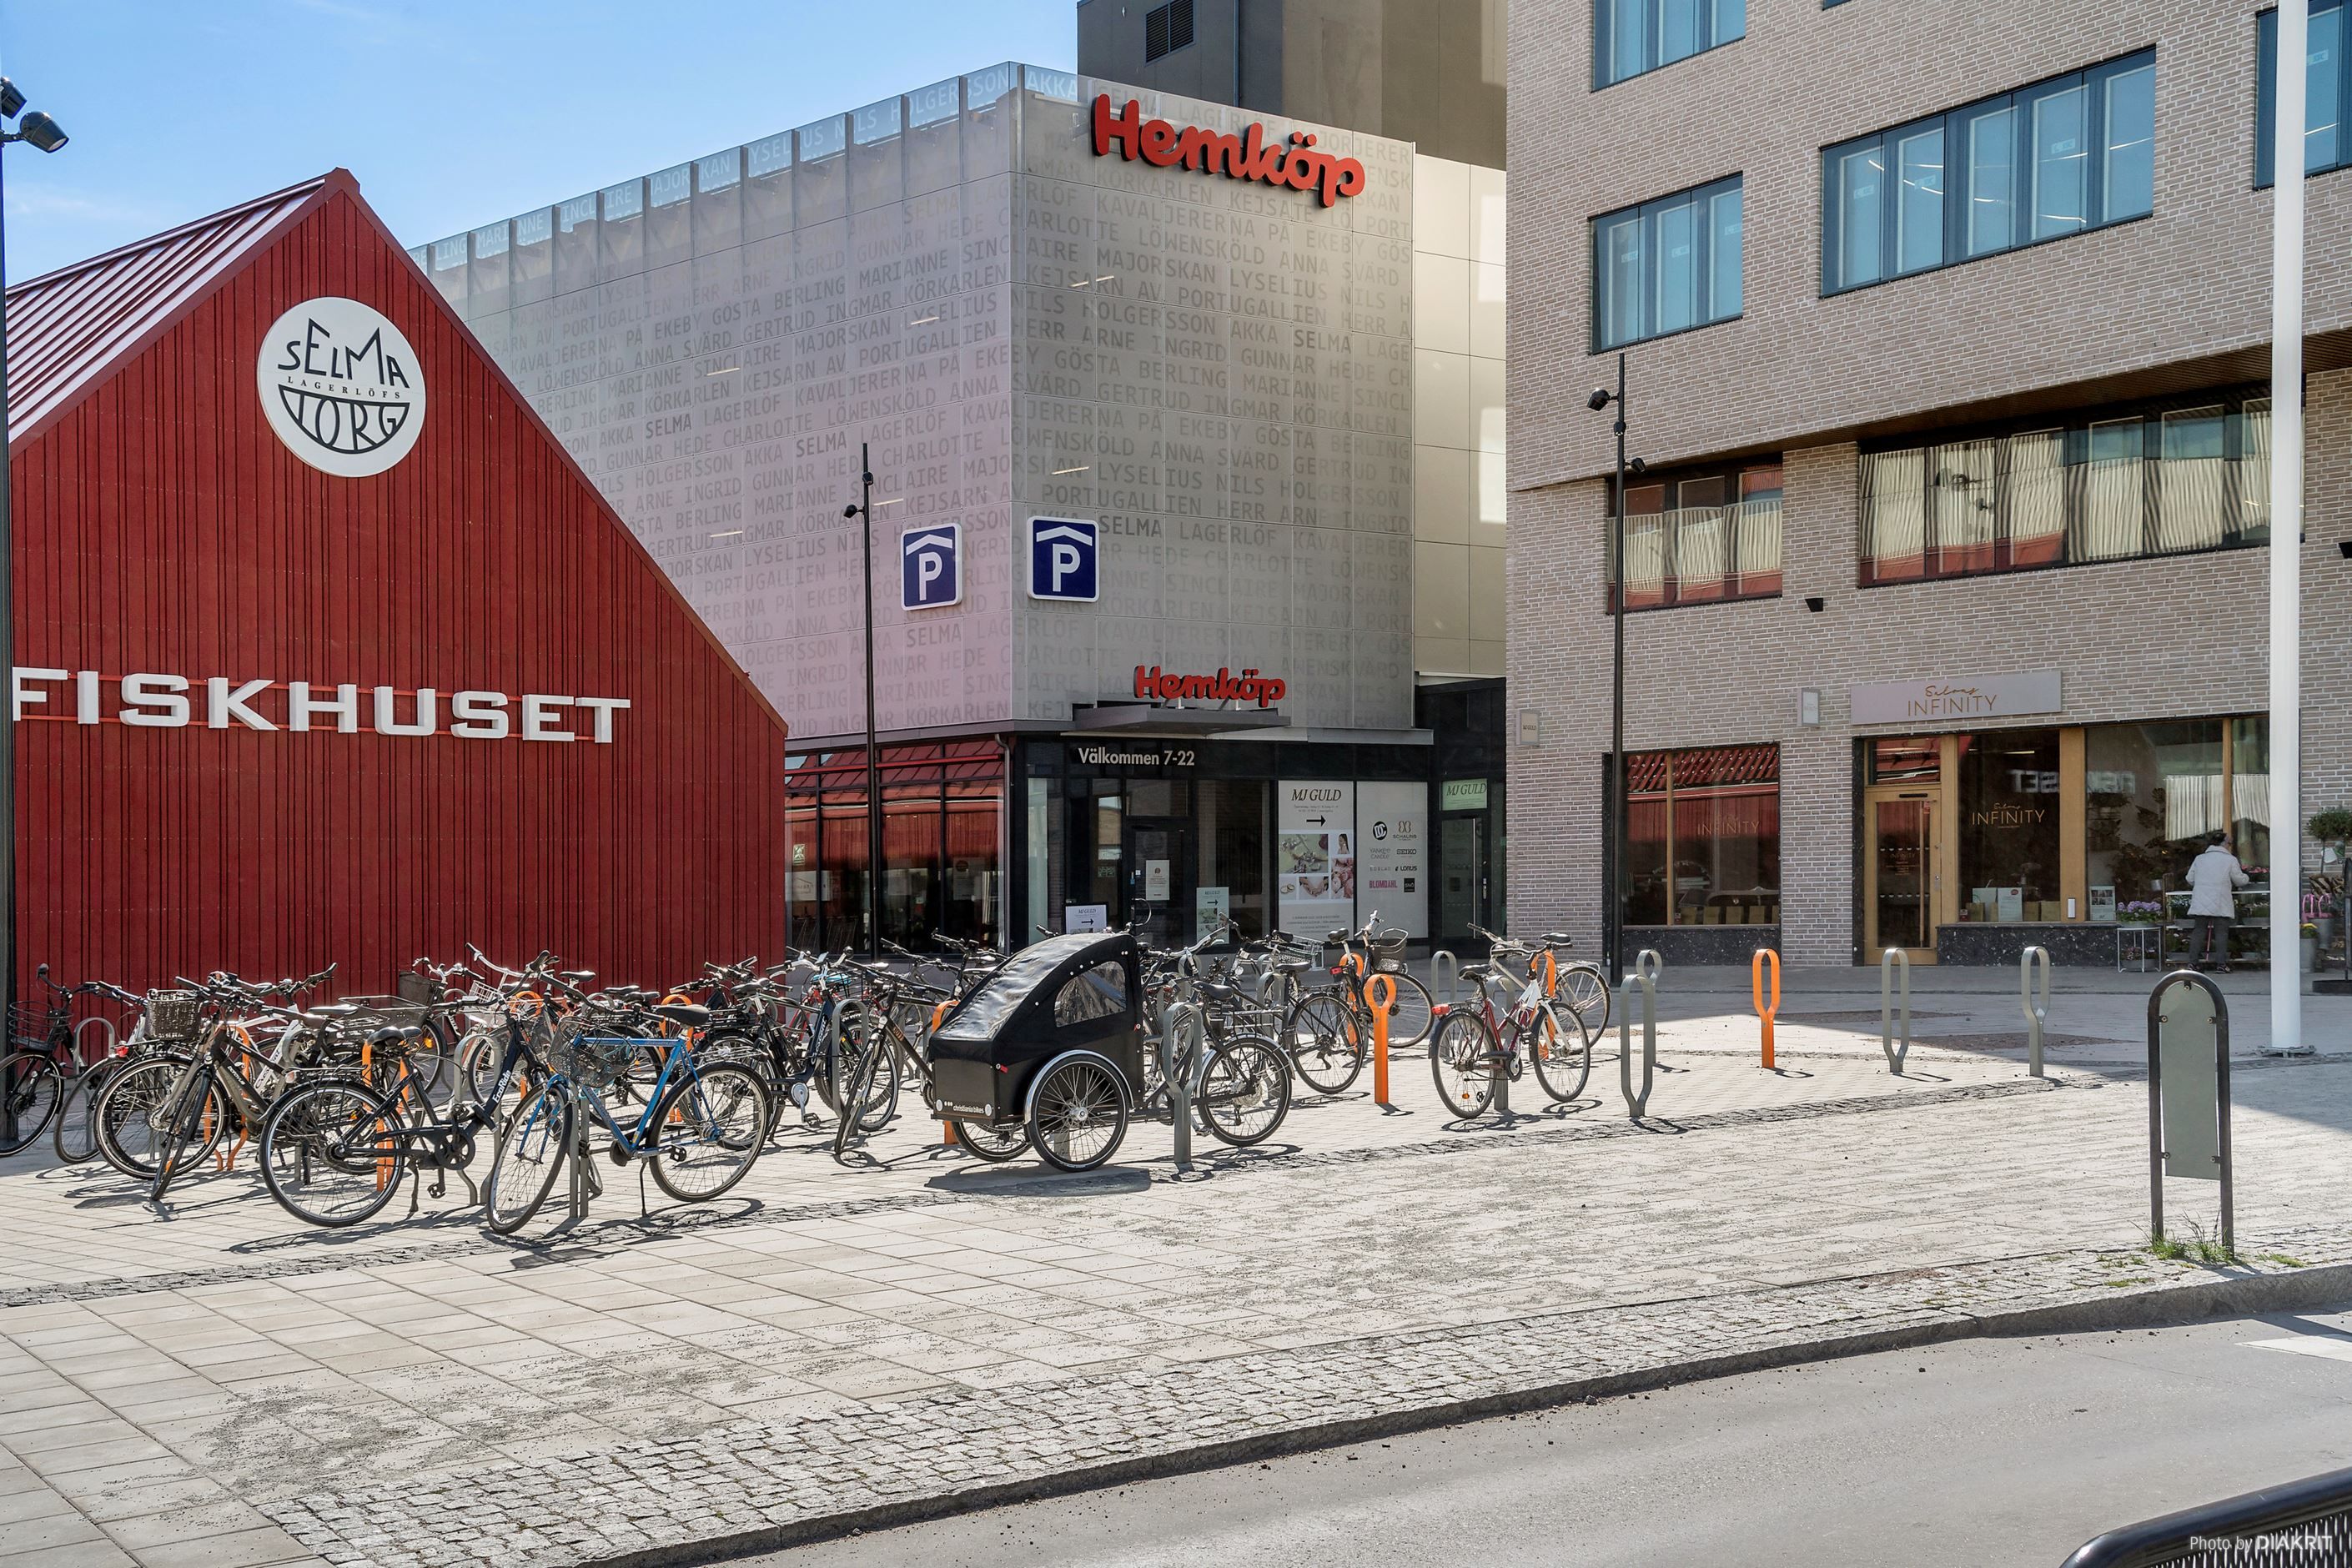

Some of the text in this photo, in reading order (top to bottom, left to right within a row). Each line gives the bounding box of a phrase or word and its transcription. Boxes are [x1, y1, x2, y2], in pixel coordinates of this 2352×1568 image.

[1091, 93, 1366, 208] Hemköp
[555, 185, 633, 225] INCLIRE
[645, 155, 731, 198] AJORKAN
[511, 334, 616, 375] KAVALJERERNA
[626, 321, 642, 347] PÅ
[654, 312, 701, 340] EKEBY
[712, 296, 761, 325] GÖSTA
[774, 274, 846, 310] BERLING
[859, 249, 947, 289] MARIANNE
[1098, 247, 1215, 283] MAJORSKAN
[1230, 268, 1328, 299] LYSELIUS
[537, 261, 1388, 392] LÖWENSKÖLD ANNA SVÄRD GERTRUD INGMAR KÖRKARLEN KEJSARN AV PORTUGALLIEN HERR
[278, 318, 410, 389] SELMA
[537, 289, 1411, 415] BERLING MARIANNE SINCLAIRE MAJORSKAN LYSELIUS NILS HOLGERSSON AKKA SELMA LAGE
[581, 315, 1376, 429] INGMAR KÖRKARLEN KEJSARN AV PORTUGALLIEN HERR ARNE INGRID GUNNAR HEDE
[288, 376, 400, 400] LAGERLÖFS
[599, 344, 1411, 448] AKKA SELMA LAGERLÖF KAVALJERERNA PÅ GÖSTA BERLING MARIANNE SINCL
[278, 384, 410, 455] TORG
[608, 369, 1400, 470] GUNNAR HEDE CHARLOTTE LÖWENSKÖLD ANNA SVÄRD GERTRUD INGMAR KÖRKARLEN
[636, 453, 731, 489] HOLGERSSON
[743, 443, 781, 468] AKKA
[795, 430, 846, 458] SELMA
[859, 406, 947, 445] LAGERLÖF
[1138, 408, 1163, 433] PÅ
[1179, 417, 1241, 441] EKEBY
[1256, 421, 1316, 449] GÖSTA
[673, 501, 741, 530] BERLING
[753, 484, 835, 515] MARIANNE
[1098, 461, 1202, 489] LYSELIUS
[1218, 473, 1266, 495] NILS
[1098, 515, 1163, 538] SELMA
[918, 551, 942, 601] P
[1053, 543, 1081, 592] P
[904, 623, 959, 648] SELMA
[13, 666, 631, 744] FISKHUSET
[1133, 665, 1285, 708] Hemköp
[1907, 695, 1997, 716] INFINITY
[1078, 747, 1195, 766] Välkommen 7-22
[1292, 789, 1342, 802] MJ GULD
[1460, 782, 1487, 795] GULD
[1972, 810, 2045, 826] INFINITY
[1369, 880, 1398, 888] BLOMDAHL
[492, 1069, 511, 1103] EcoRide
